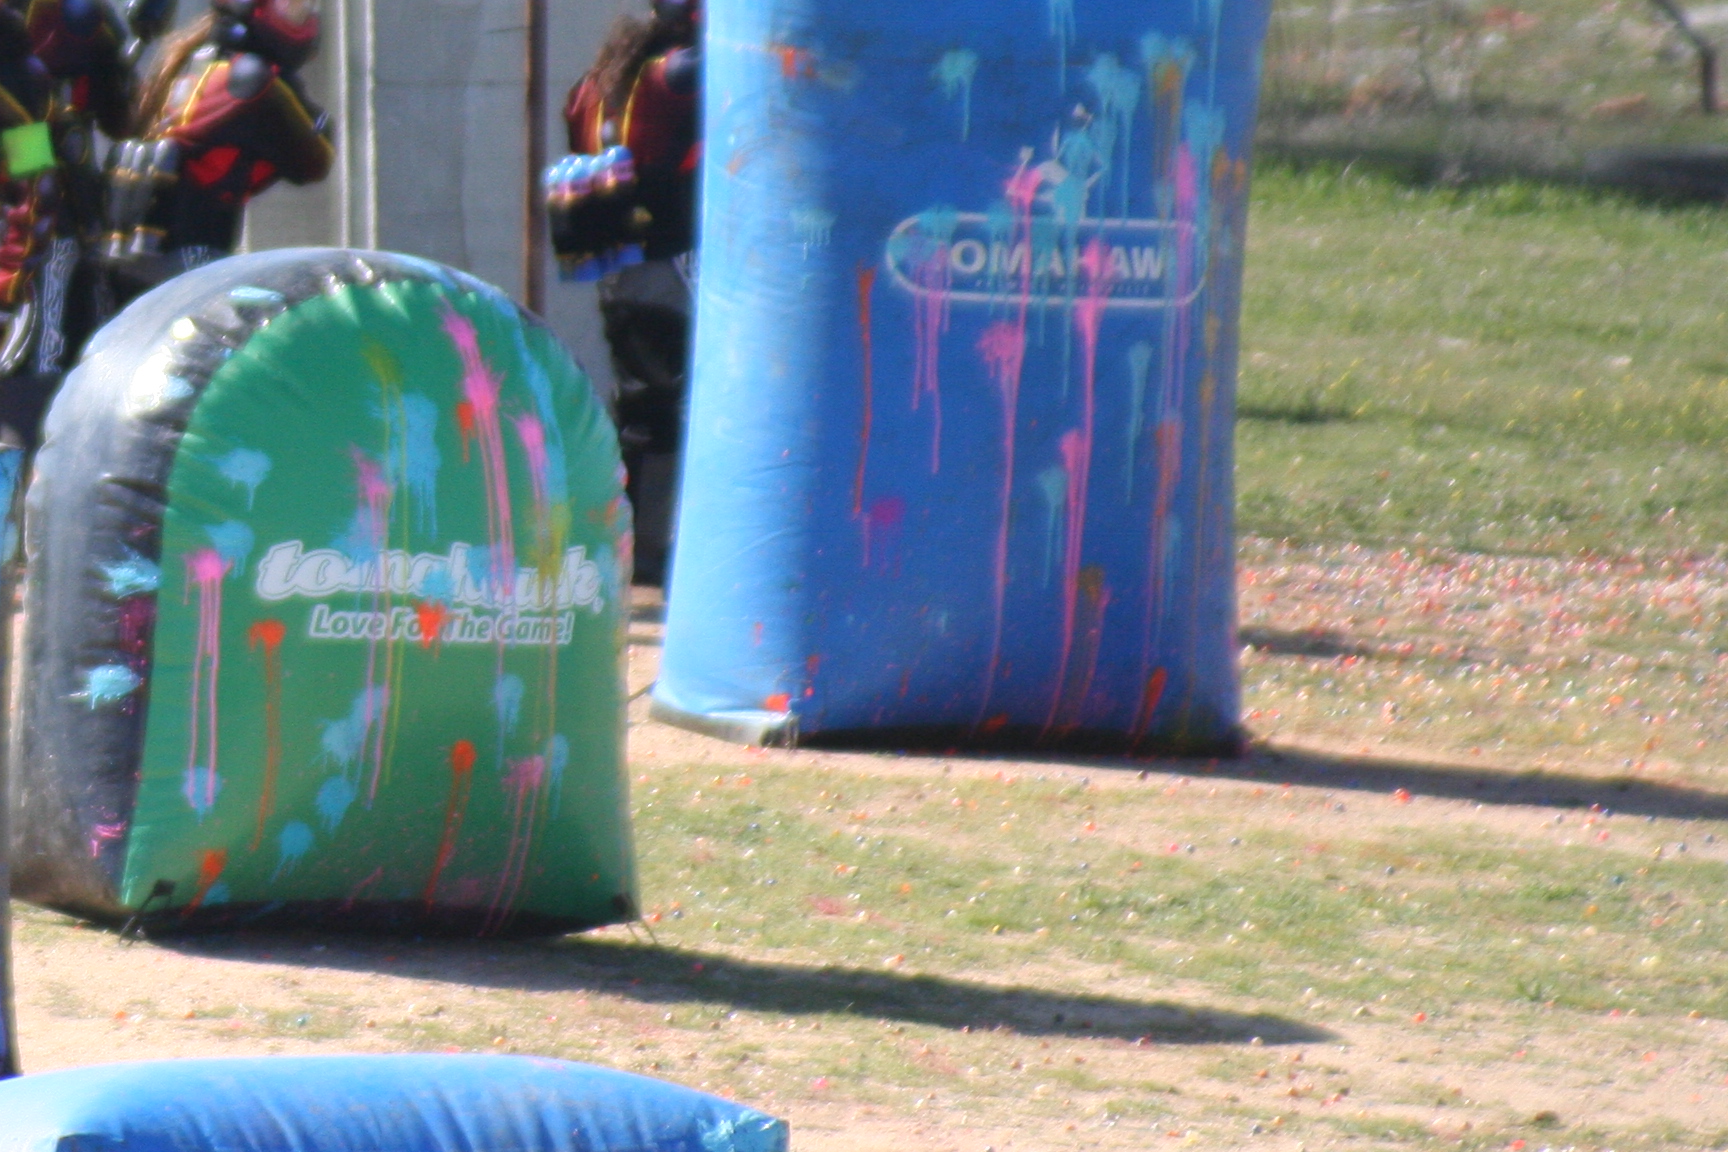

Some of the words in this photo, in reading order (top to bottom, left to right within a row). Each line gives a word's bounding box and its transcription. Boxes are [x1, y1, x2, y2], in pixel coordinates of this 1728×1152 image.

[928, 239, 1184, 281] OMAHAW
[310, 604, 386, 639] Love
[388, 606, 440, 641] Fo
[442, 608, 493, 643] The
[494, 608, 575, 645] Game!
